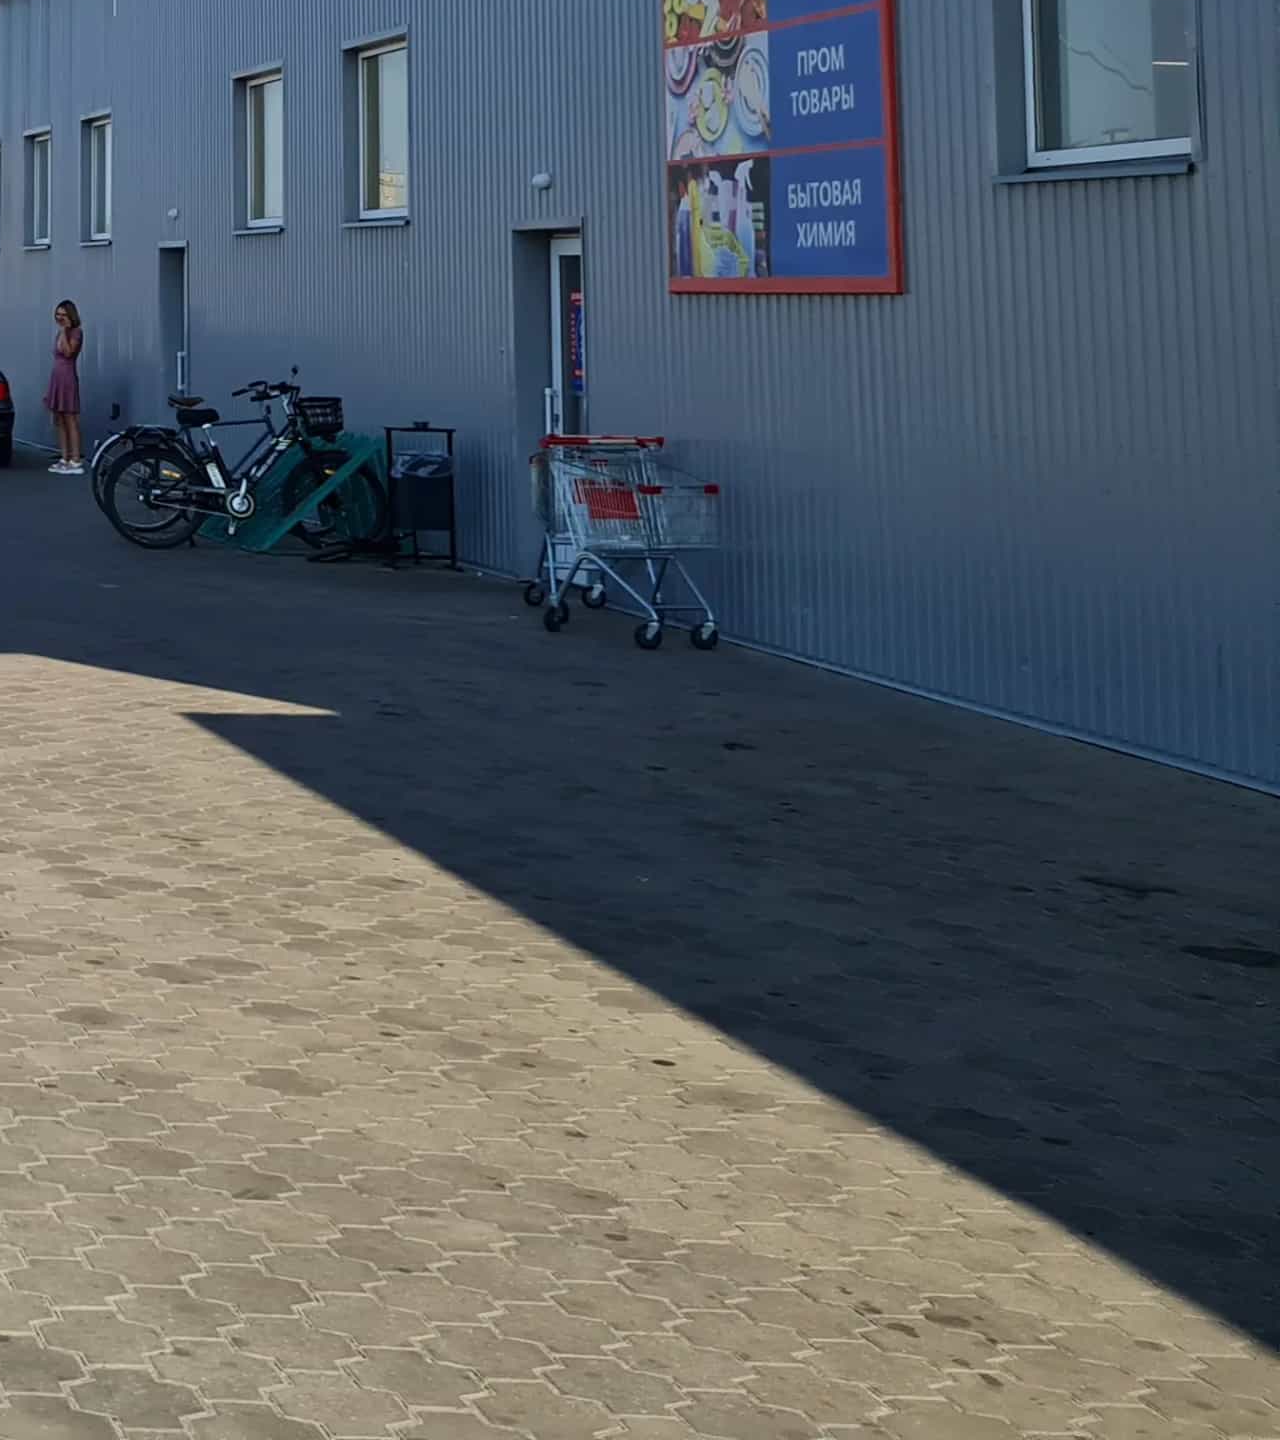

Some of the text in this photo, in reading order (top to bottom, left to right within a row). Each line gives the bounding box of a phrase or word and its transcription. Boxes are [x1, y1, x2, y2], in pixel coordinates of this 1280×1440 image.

[797, 44, 845, 76] ПРОМ
[790, 83, 855, 116] ТОВАРЫ
[787, 178, 862, 209] БЫТОВАЯ
[796, 220, 856, 248] ХИМИЯ
